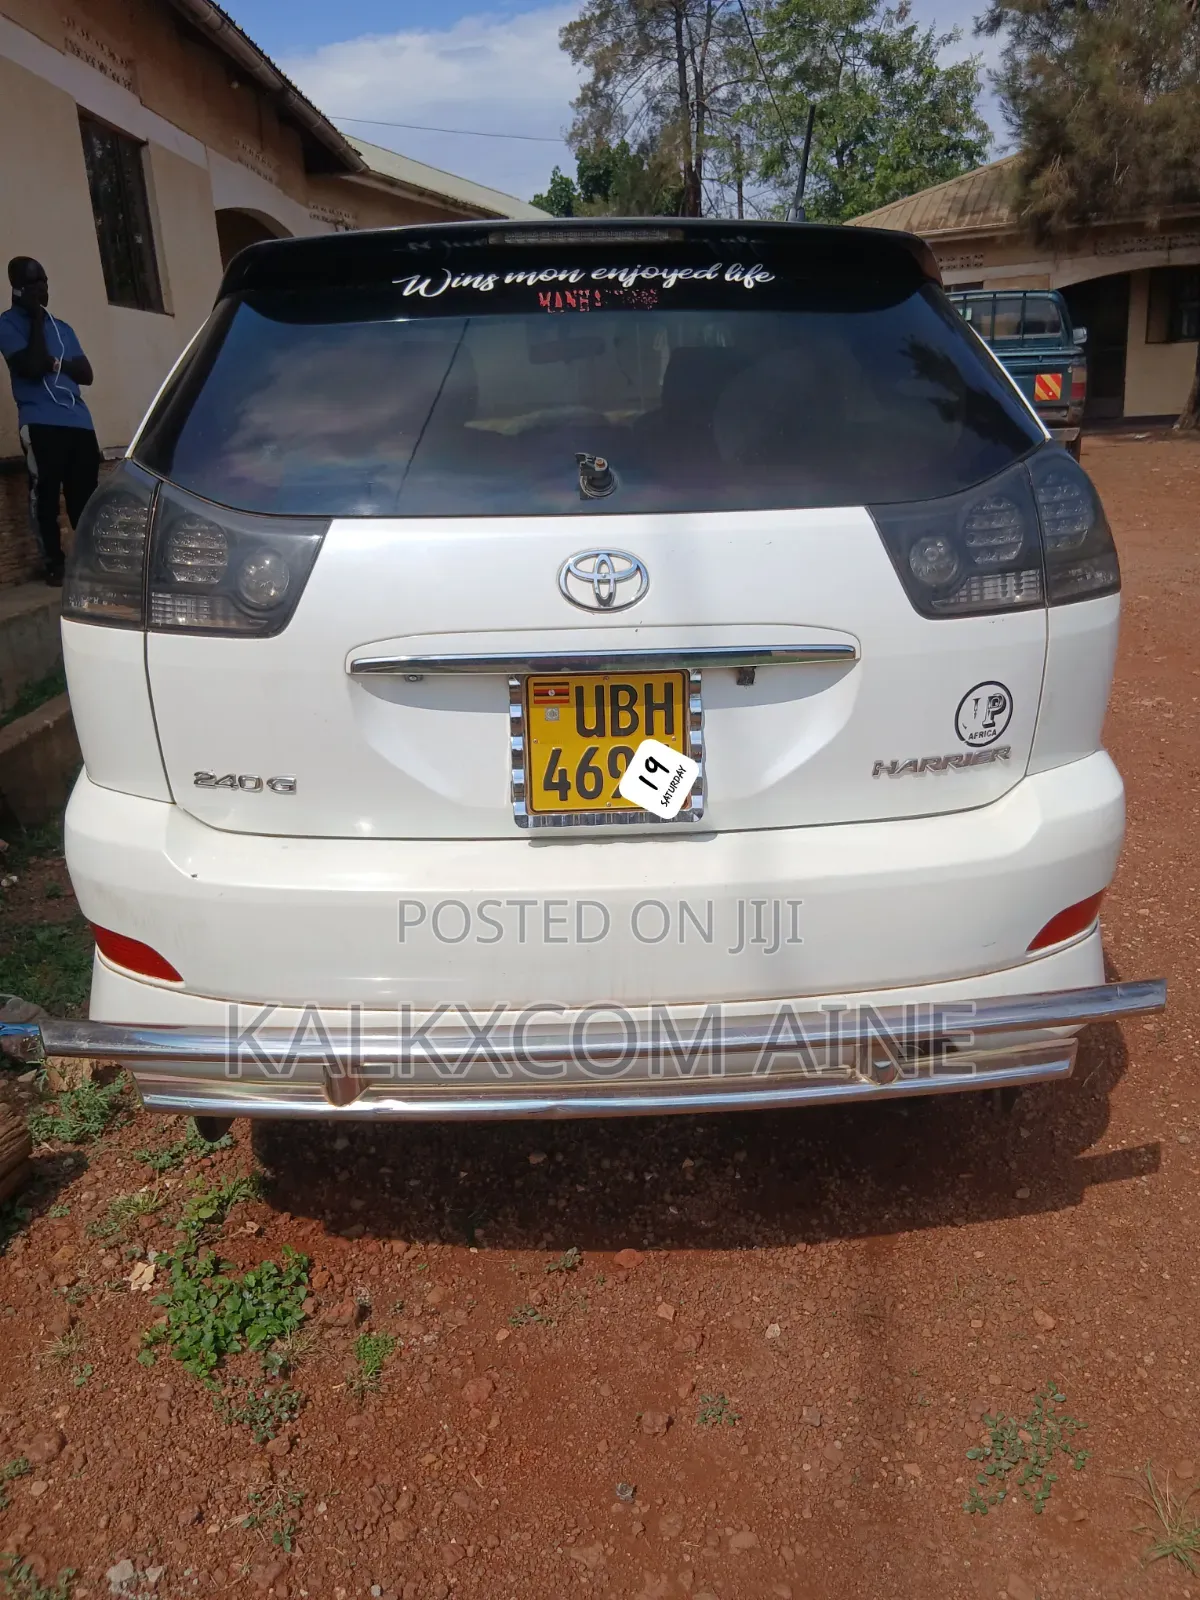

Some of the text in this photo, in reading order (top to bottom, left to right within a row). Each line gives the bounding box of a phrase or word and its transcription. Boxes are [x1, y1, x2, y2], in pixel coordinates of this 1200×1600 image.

[392, 263, 775, 297] Wins mon enjoyed life
[575, 682, 675, 737] UBH
[968, 729, 997, 740] AFRICA
[543, 744, 669, 801] 469
[872, 746, 1011, 777] HARRIER
